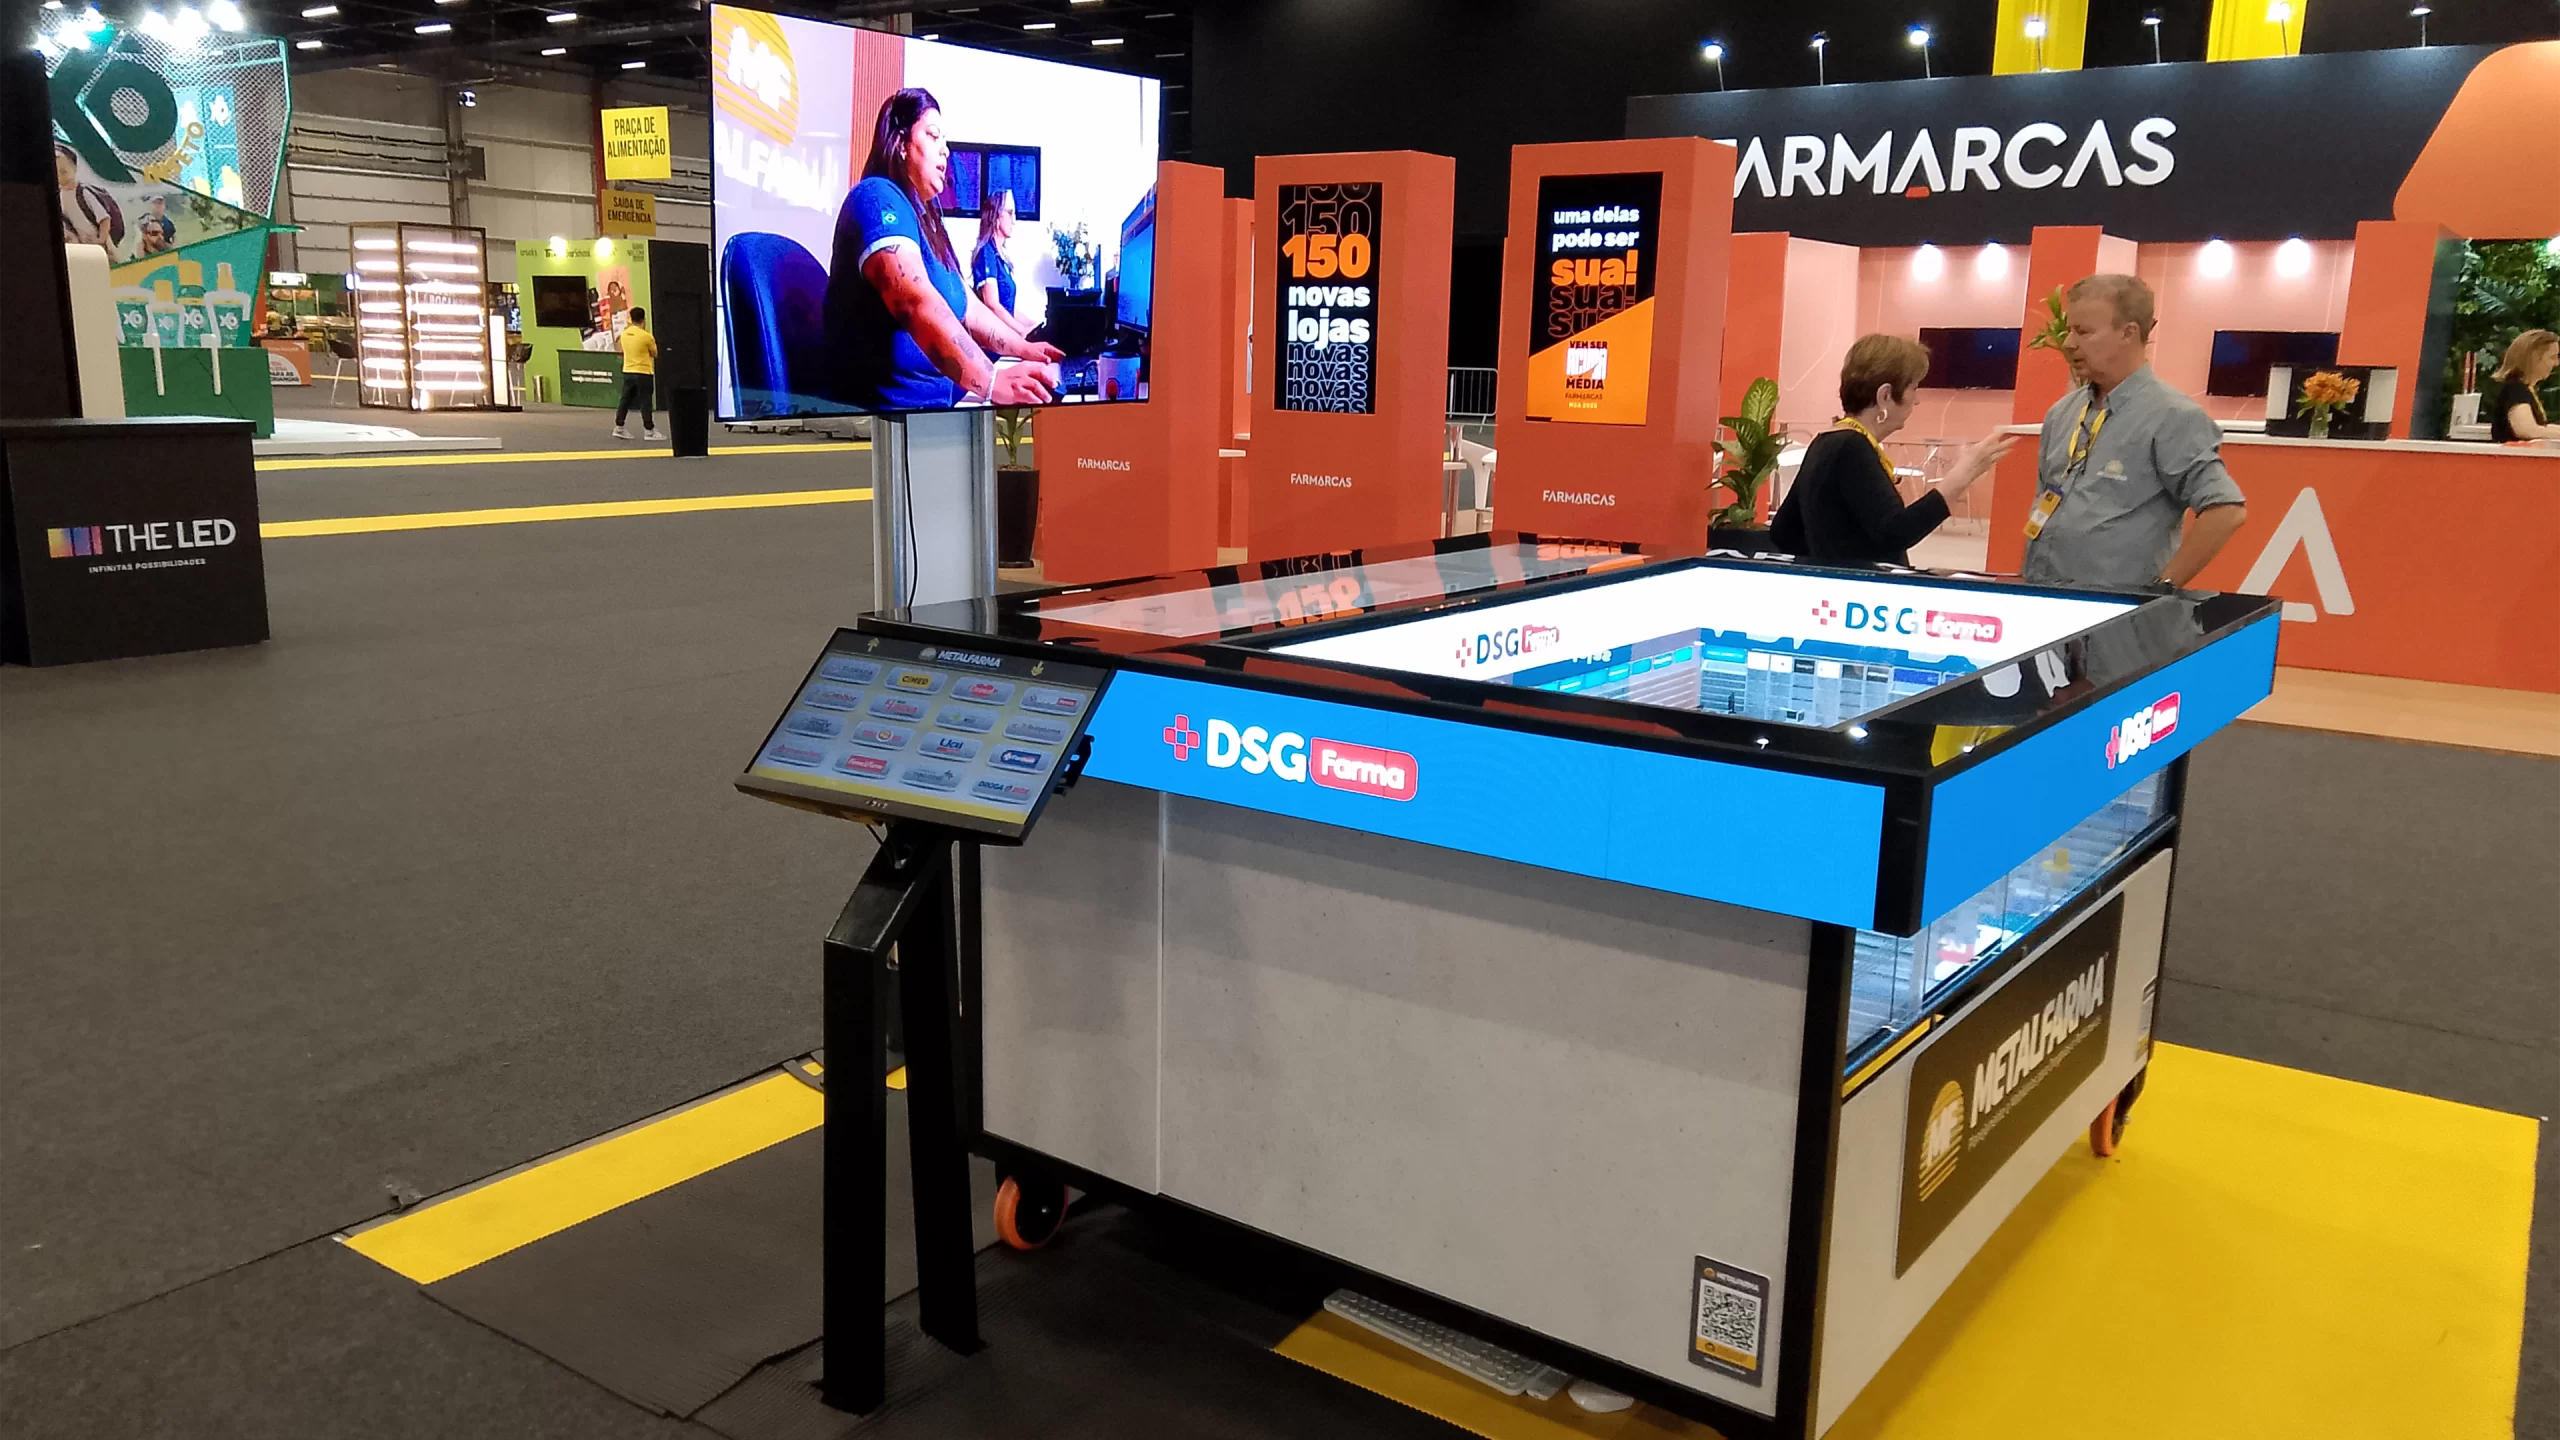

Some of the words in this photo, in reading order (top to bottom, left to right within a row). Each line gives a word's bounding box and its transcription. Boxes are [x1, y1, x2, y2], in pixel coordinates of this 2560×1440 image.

[614, 117, 642, 138] PRAÇA
[645, 116, 655, 133] DE
[607, 135, 666, 159] ALIMENTAÇÃO
[1713, 117, 2177, 198] ARMARCAS
[613, 196, 634, 210] SAÍDA
[636, 199, 645, 210] DE
[1553, 210, 1591, 224] uma
[1592, 205, 1639, 223] delas
[607, 209, 652, 223] EMERGÊNCIA
[1552, 228, 1603, 252] pode
[1604, 231, 1640, 247] ser
[1282, 233, 1371, 278] 150
[1551, 249, 1639, 286] sua!
[1288, 286, 1371, 307] novas
[1288, 308, 1371, 350] lojas
[1287, 342, 1369, 364] novas
[1569, 340, 1588, 349] VEM
[1590, 341, 1608, 349] SER
[1287, 360, 1368, 383] novas
[1566, 375, 1604, 390] MÉDIA
[1286, 378, 1367, 401] novas
[1077, 457, 1131, 471] FARMARCAS
[1290, 473, 1352, 488] FARMARCAS
[1543, 489, 1616, 506] FARMARCAS
[105, 522, 173, 553] THE
[175, 519, 237, 548] LED
[89, 563, 133, 573] INFINITAS
[135, 558, 206, 570] POSSIBILIDADES
[1845, 602, 1918, 634] DSG
[1476, 628, 1519, 665] DSG
[938, 650, 1002, 668] METALFARMA
[1207, 719, 1307, 783] DSG
[1321, 749, 1405, 790] Farma
[1969, 956, 2106, 1129] METALFARMA
[1926, 1099, 1959, 1168] MF
